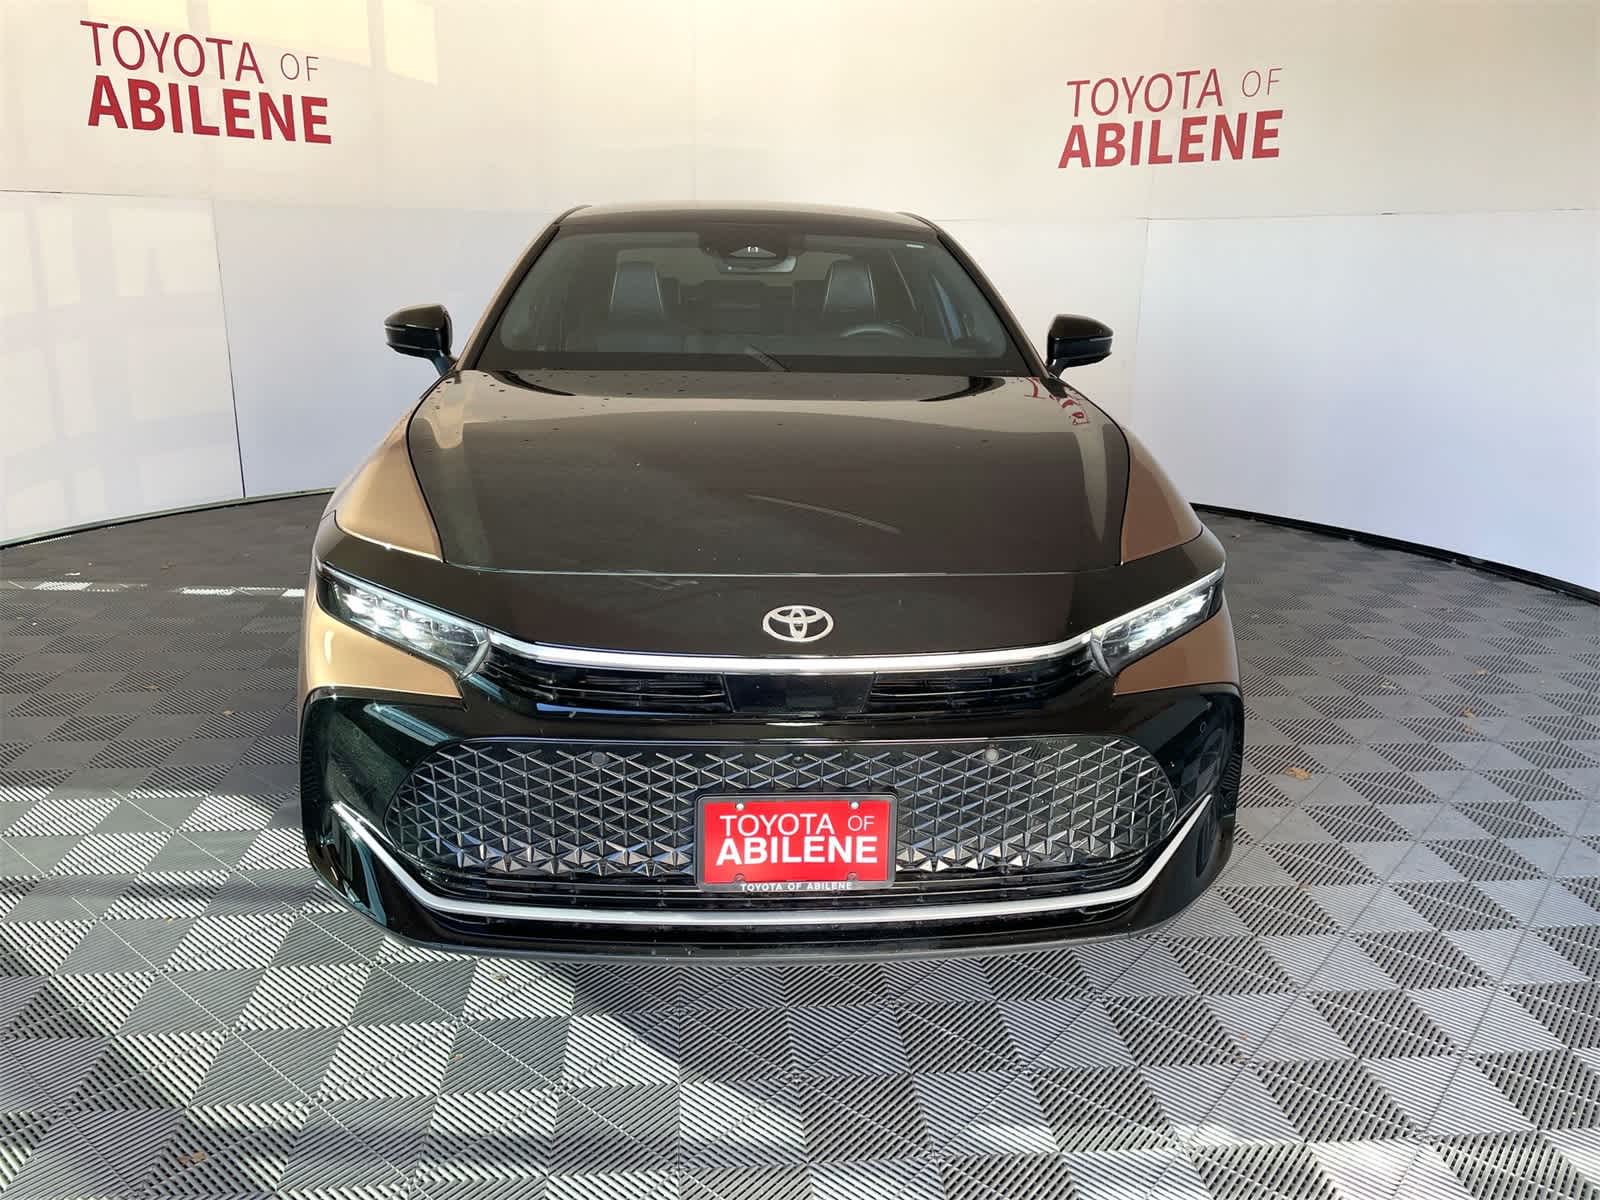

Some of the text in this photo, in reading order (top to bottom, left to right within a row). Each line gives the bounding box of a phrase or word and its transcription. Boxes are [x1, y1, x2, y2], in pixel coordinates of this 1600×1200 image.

[80, 20, 320, 84] TOYOTA OF
[88, 75, 332, 144] ABILENE
[1066, 68, 1283, 117] TOYOTA OF
[1057, 109, 1284, 168] ABILENE
[719, 813, 875, 836] TOYOTA OF
[716, 836, 878, 866] ABILENE
[741, 881, 852, 892] TOYOTA OF ABILENE
